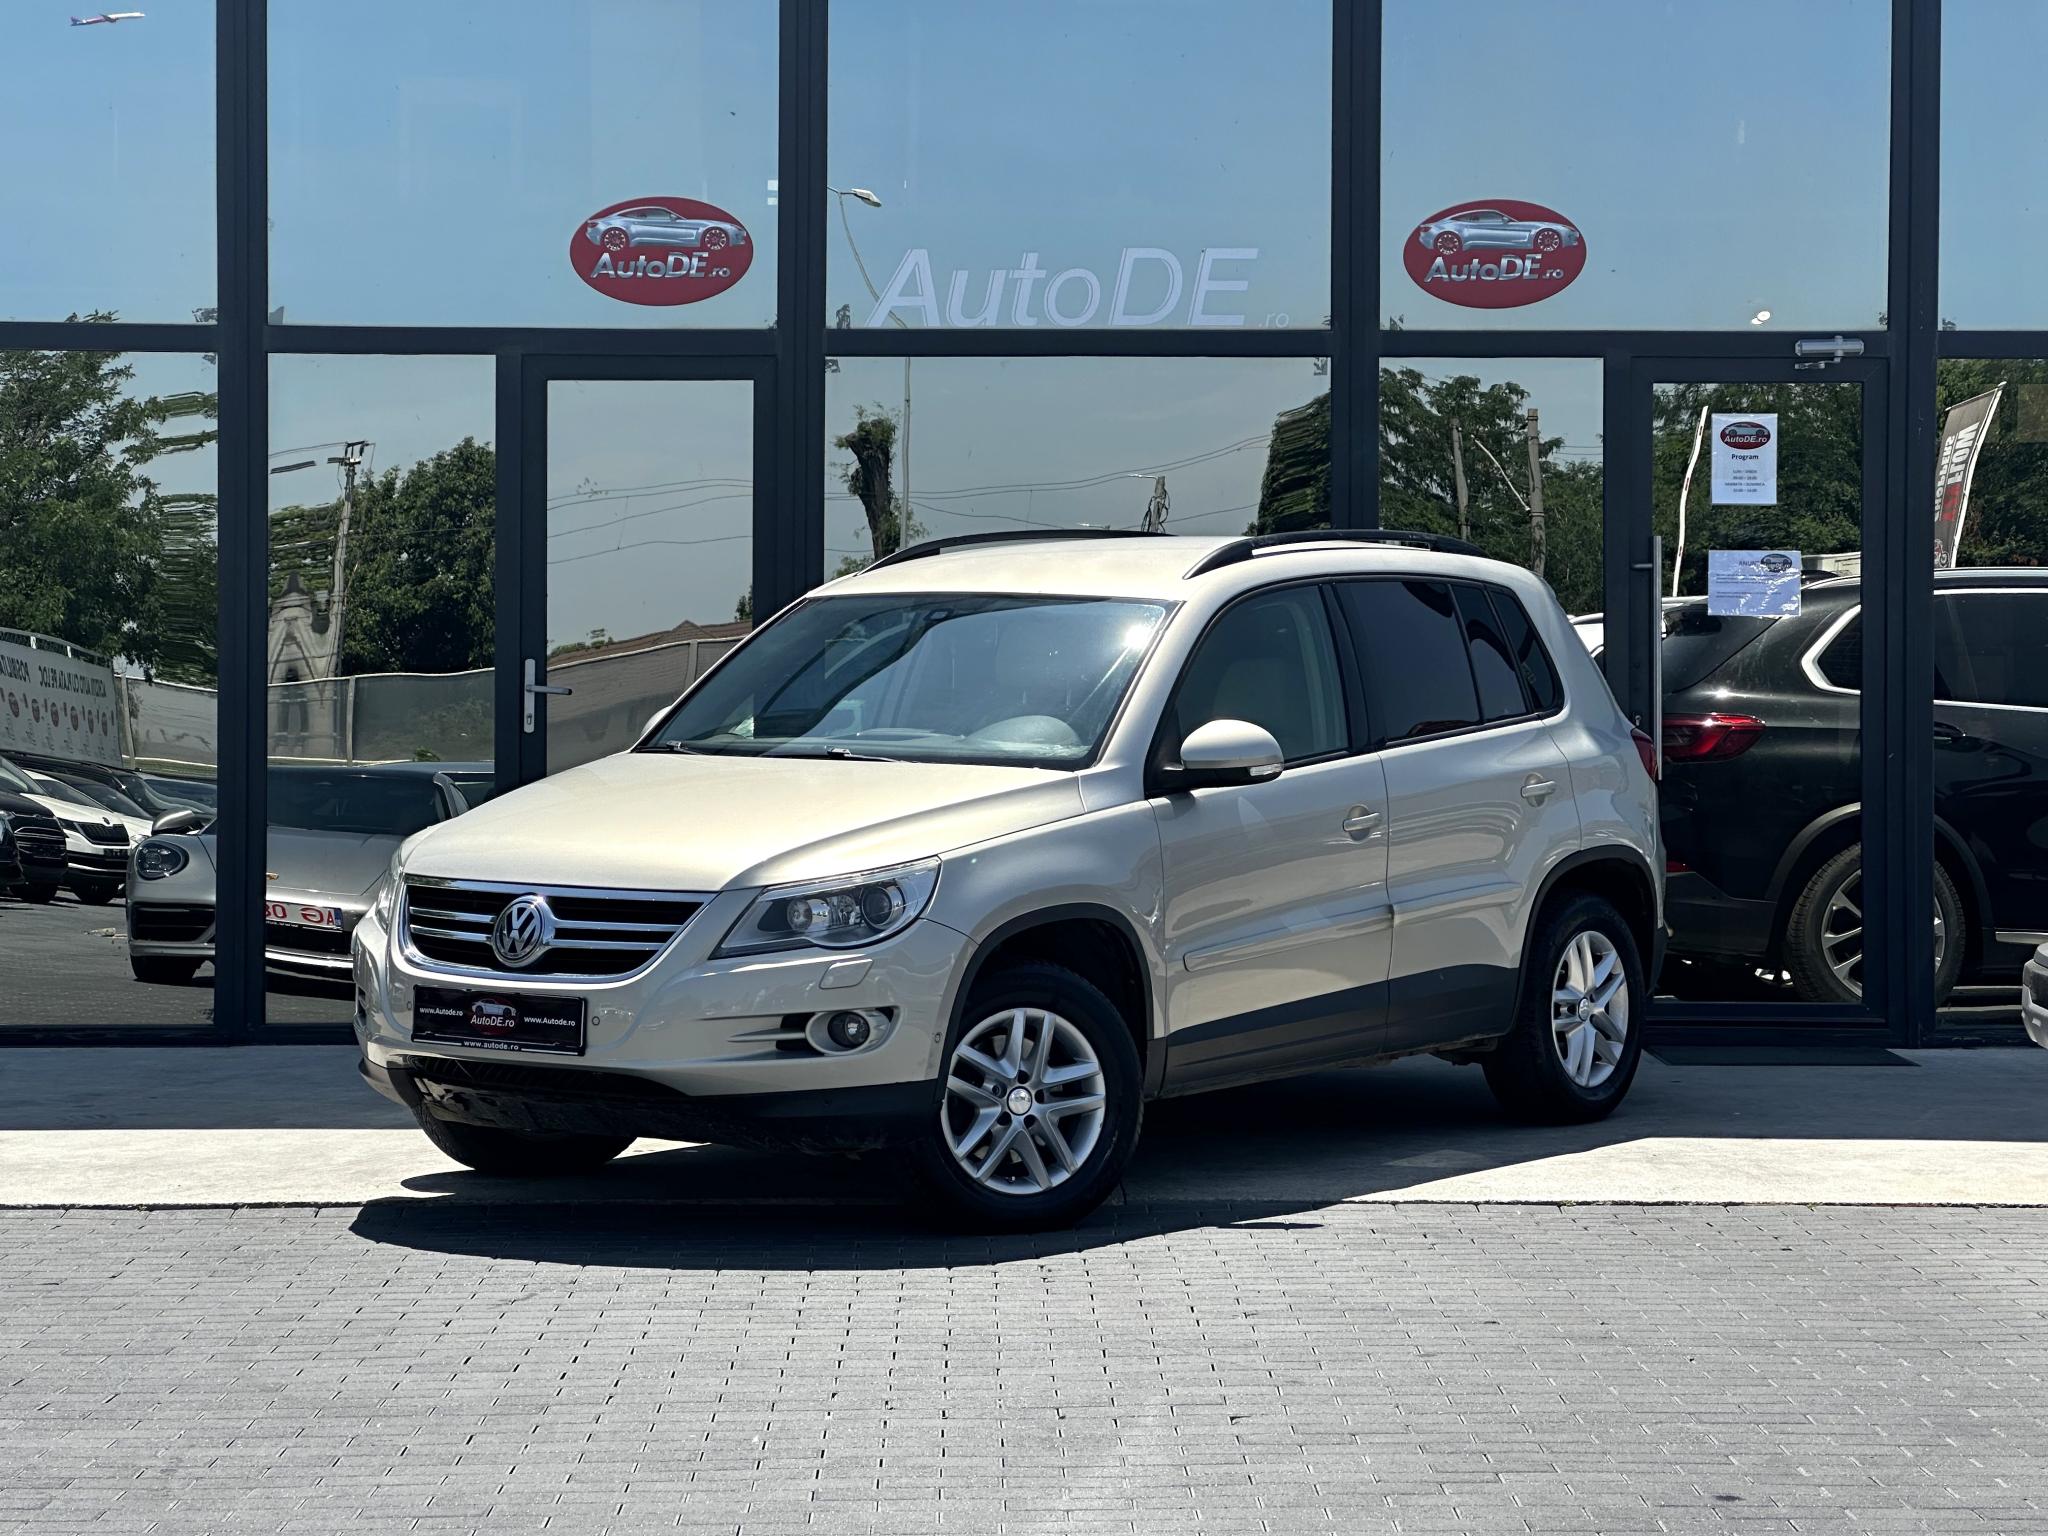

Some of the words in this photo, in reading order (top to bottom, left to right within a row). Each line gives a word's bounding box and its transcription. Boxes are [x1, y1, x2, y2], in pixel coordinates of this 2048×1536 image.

[1724, 435, 1768, 443] AutoDE.ro
[1731, 453, 1759, 461] Program
[419, 1006, 464, 1017] www.Autode.ro
[470, 1014, 515, 1028] AutoDE.ro
[523, 1016, 576, 1027] www.Autode.ro
[464, 1040, 519, 1051] www.autode.ro
